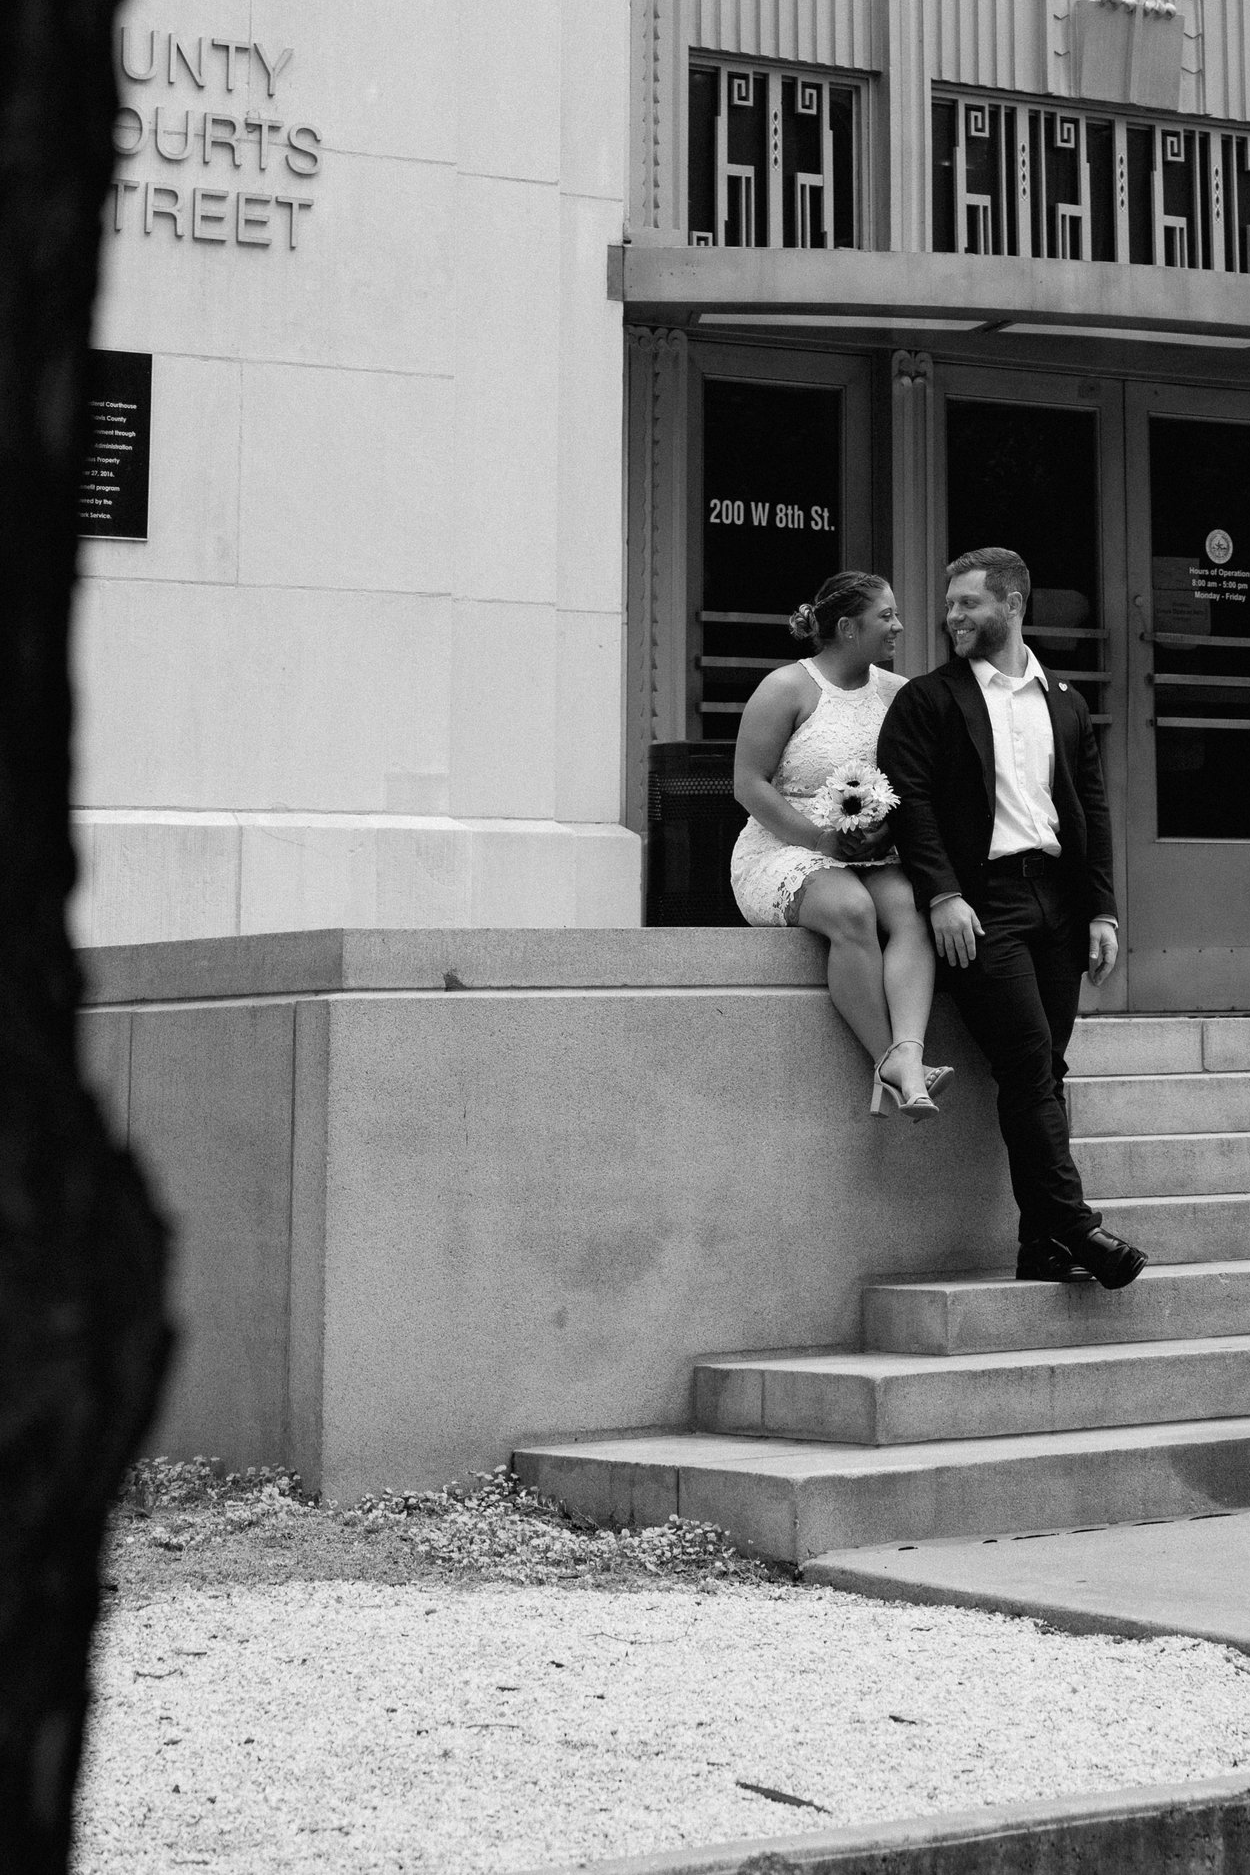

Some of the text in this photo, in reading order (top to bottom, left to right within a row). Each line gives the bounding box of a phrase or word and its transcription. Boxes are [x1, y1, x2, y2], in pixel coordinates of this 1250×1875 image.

[120, 26, 295, 99] UNTY
[113, 106, 322, 176] OURTS
[112, 179, 314, 250] TREET
[105, 401, 138, 410] Courthouse
[106, 415, 128, 424] County
[114, 430, 137, 438] through
[97, 456, 121, 465] Property
[96, 485, 121, 493] program
[94, 498, 103, 506] by
[709, 498, 835, 531] 200 W 8th St.
[1189, 567, 1250, 578] Hours of Operation
[1192, 579, 1206, 587] 8:00
[1222, 581, 1236, 589] 5:00
[1194, 591, 1220, 601] Monday
[1225, 593, 1246, 603] Friday
